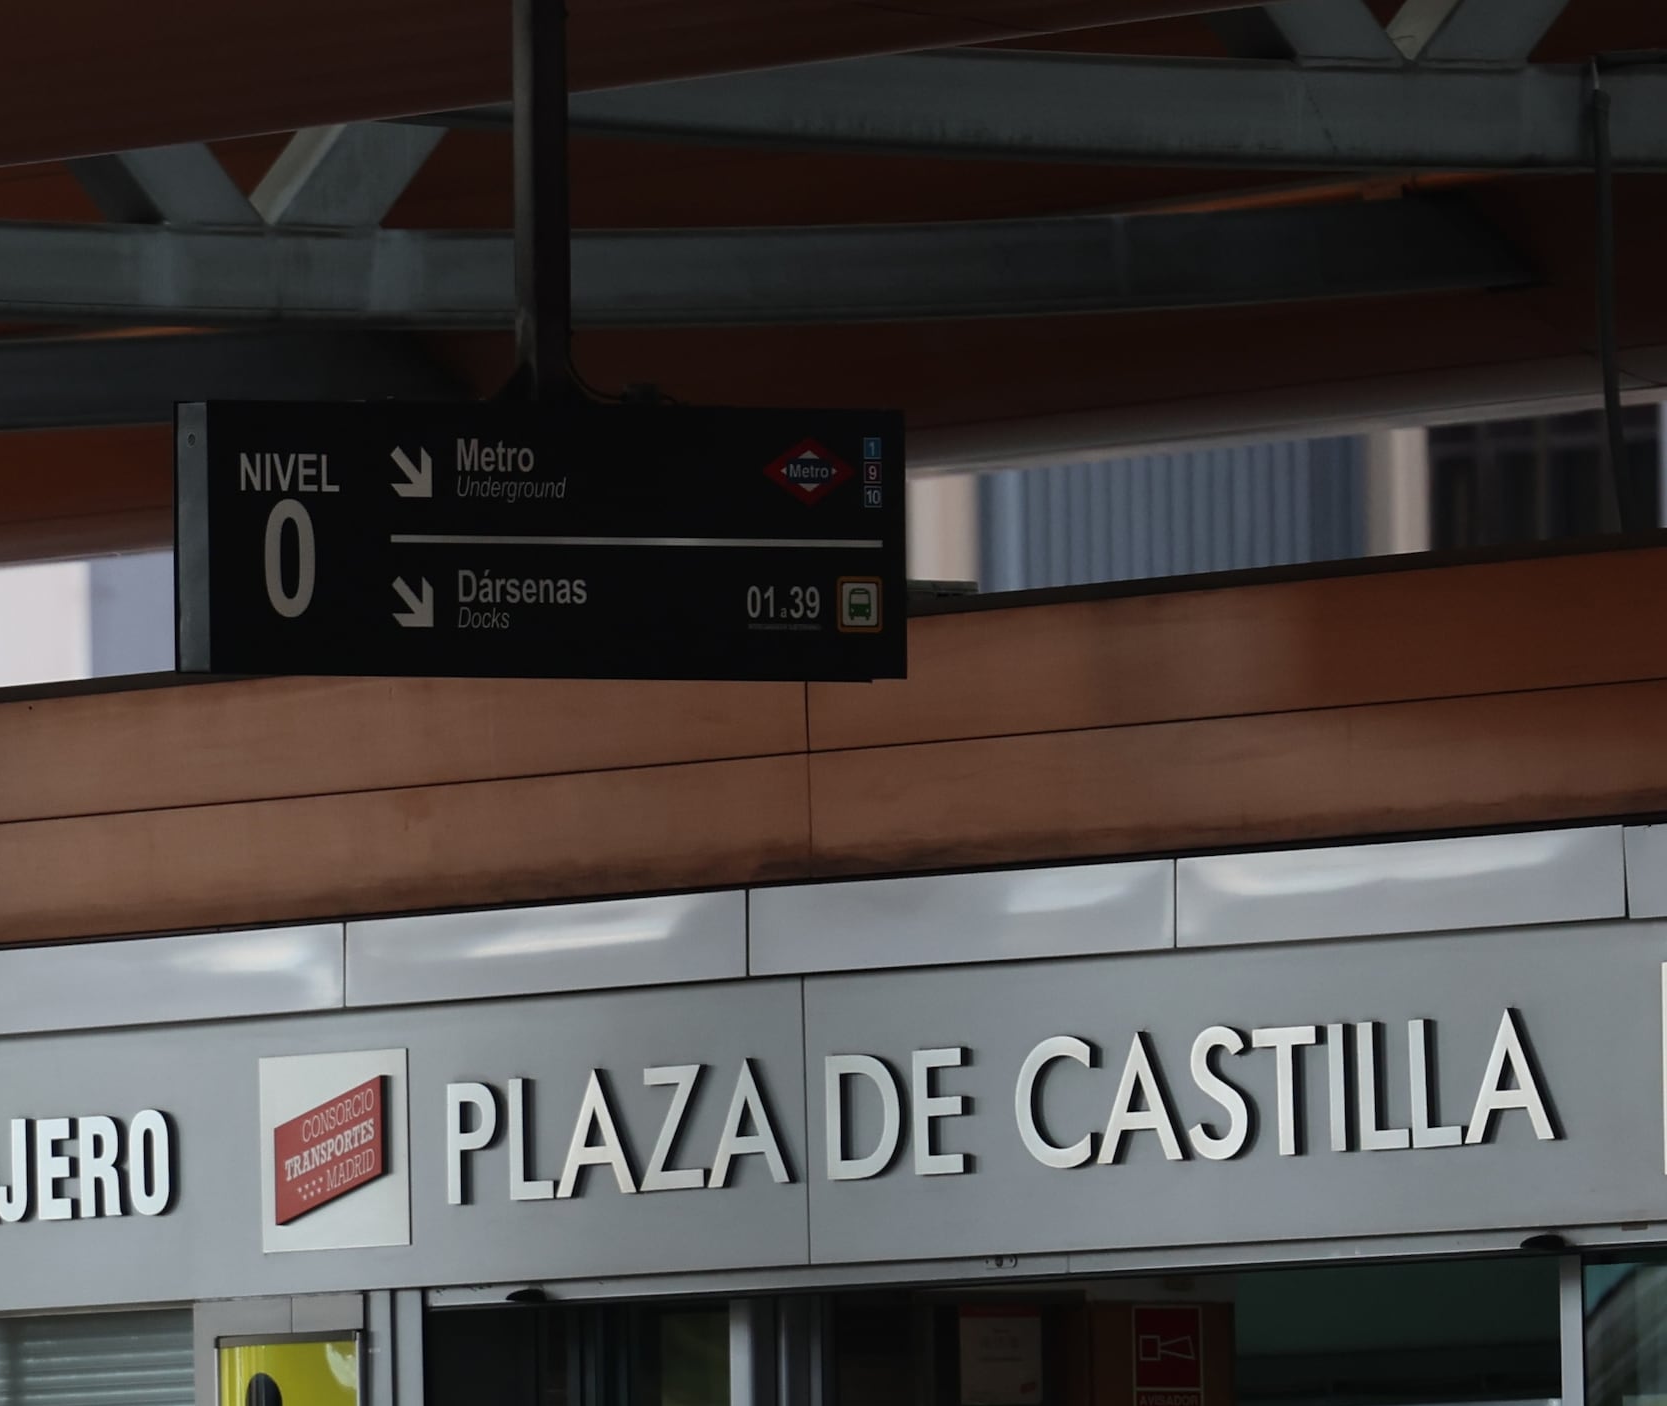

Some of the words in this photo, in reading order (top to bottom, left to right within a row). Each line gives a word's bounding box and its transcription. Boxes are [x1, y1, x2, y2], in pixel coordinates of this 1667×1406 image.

[240, 453, 340, 493] NIVEL
[457, 438, 534, 473] Metro
[789, 463, 830, 481] Metro
[868, 466, 878, 480] 9
[457, 475, 566, 504] Underground
[865, 488, 880, 505] 10
[264, 499, 316, 618] 0
[458, 570, 588, 605] Dársenas
[458, 607, 510, 630] Docks
[302, 1088, 374, 1143] CONSORCIO
[447, 1057, 795, 1203] PLAZA
[825, 1047, 971, 1181] DE
[1014, 1008, 1562, 1167] CASTILLA
[285, 1118, 375, 1181] TRANSPORTES
[326, 1148, 375, 1192] MADRID
[1139, 1395, 1198, 1406] AVISADOR
